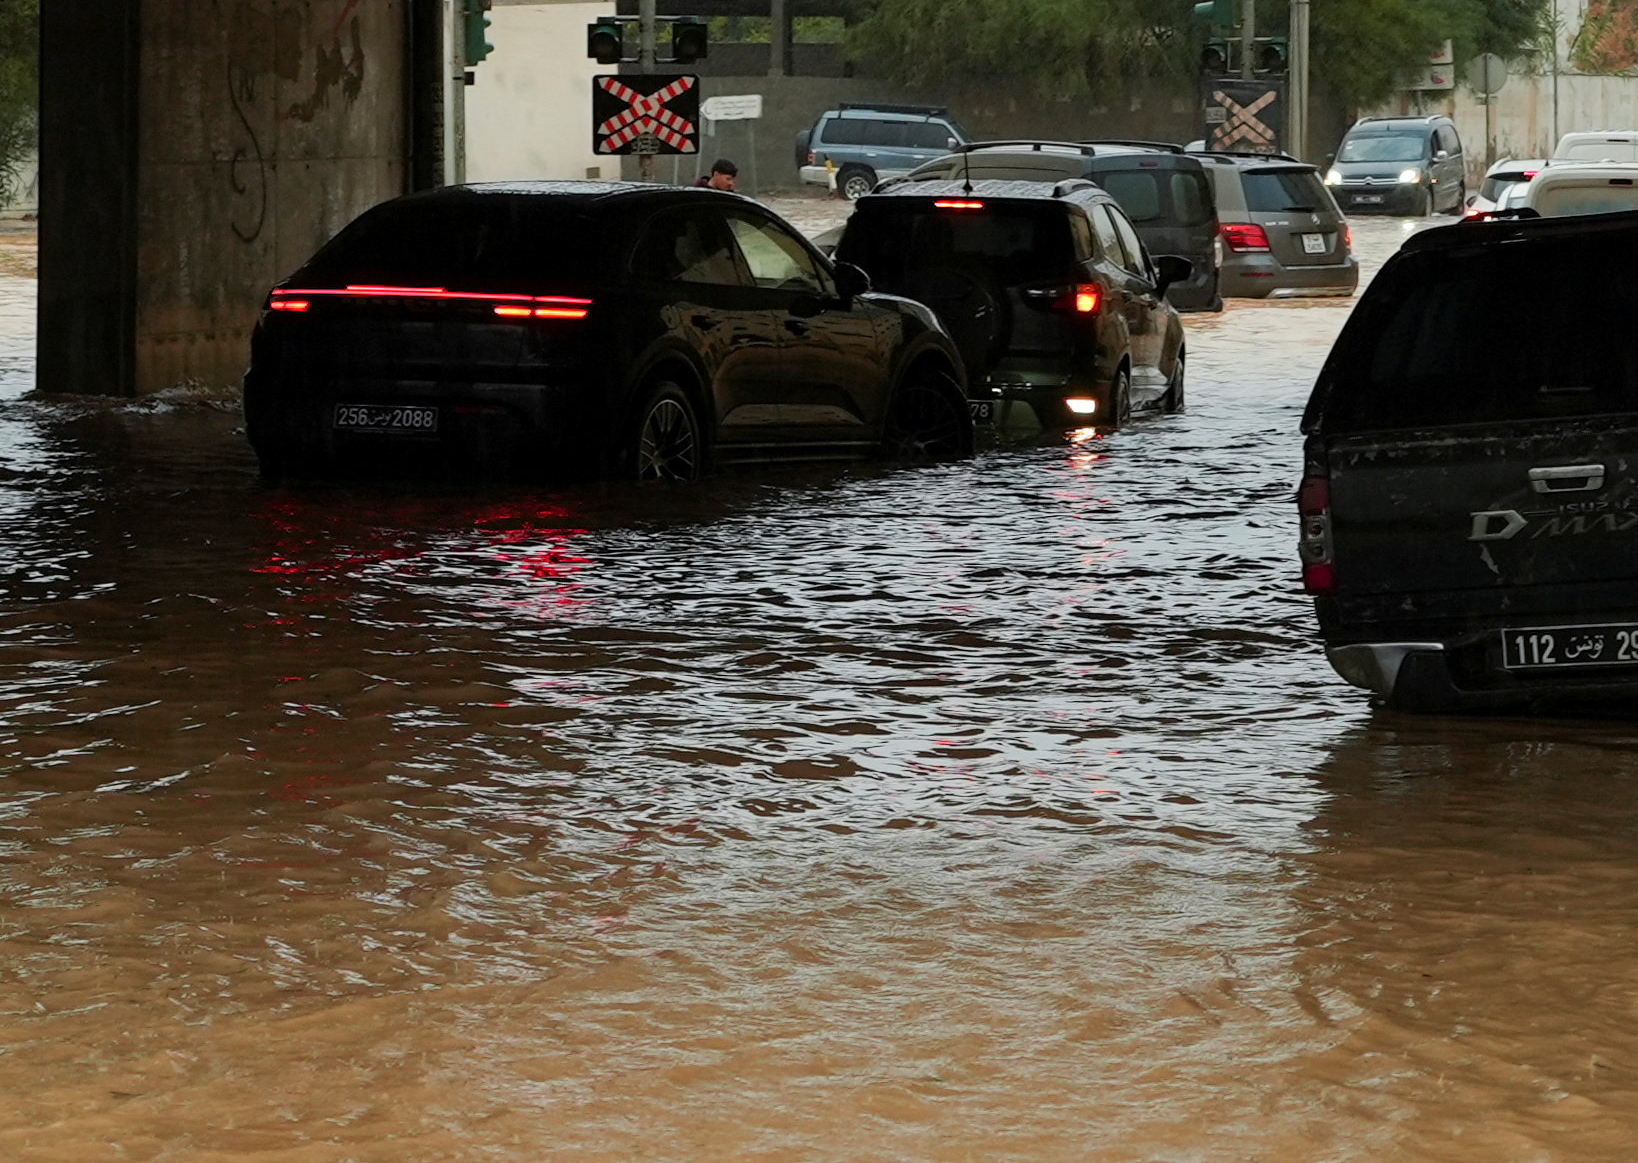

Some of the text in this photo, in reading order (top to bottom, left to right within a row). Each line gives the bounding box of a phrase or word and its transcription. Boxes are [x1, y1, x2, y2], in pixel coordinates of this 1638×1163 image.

[338, 407, 368, 426] 256
[393, 409, 434, 428] 2088
[1515, 633, 1556, 665] 112
[1565, 634, 1605, 659] تونس
